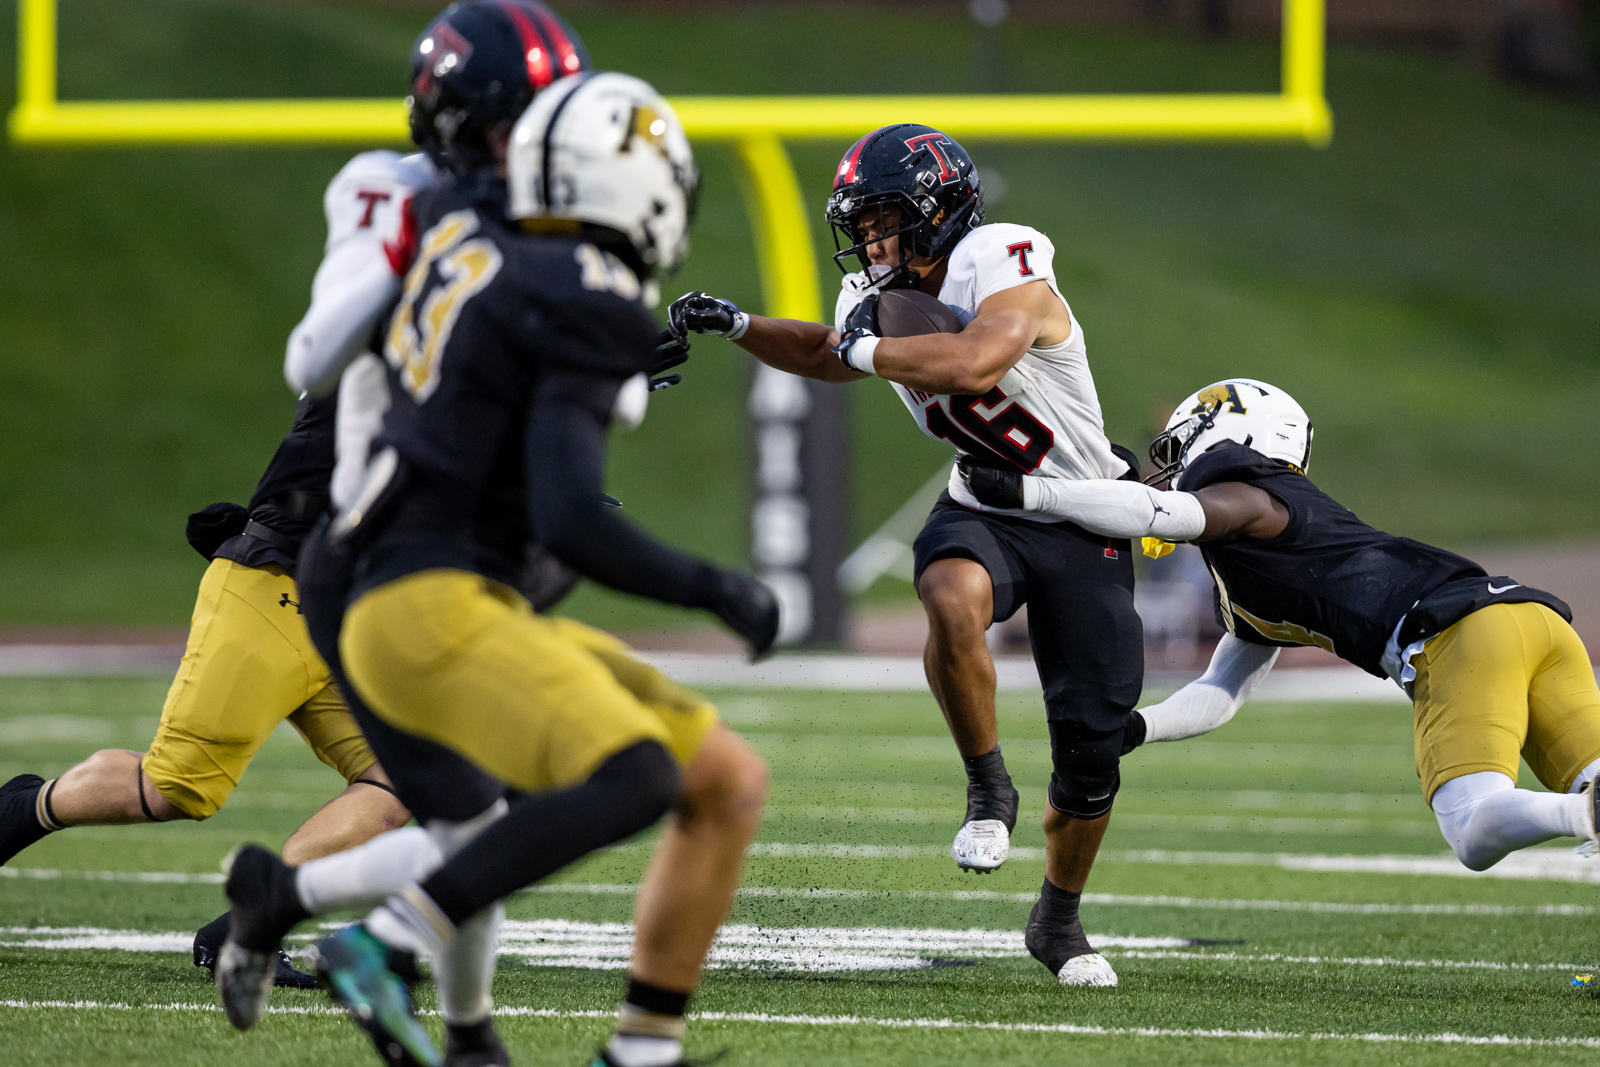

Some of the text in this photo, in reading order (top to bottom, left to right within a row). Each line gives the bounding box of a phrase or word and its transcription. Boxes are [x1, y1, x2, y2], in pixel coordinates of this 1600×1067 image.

[904, 133, 960, 186] T
[357, 190, 391, 229] T
[1006, 240, 1034, 277] T
[925, 385, 1055, 475] 16
